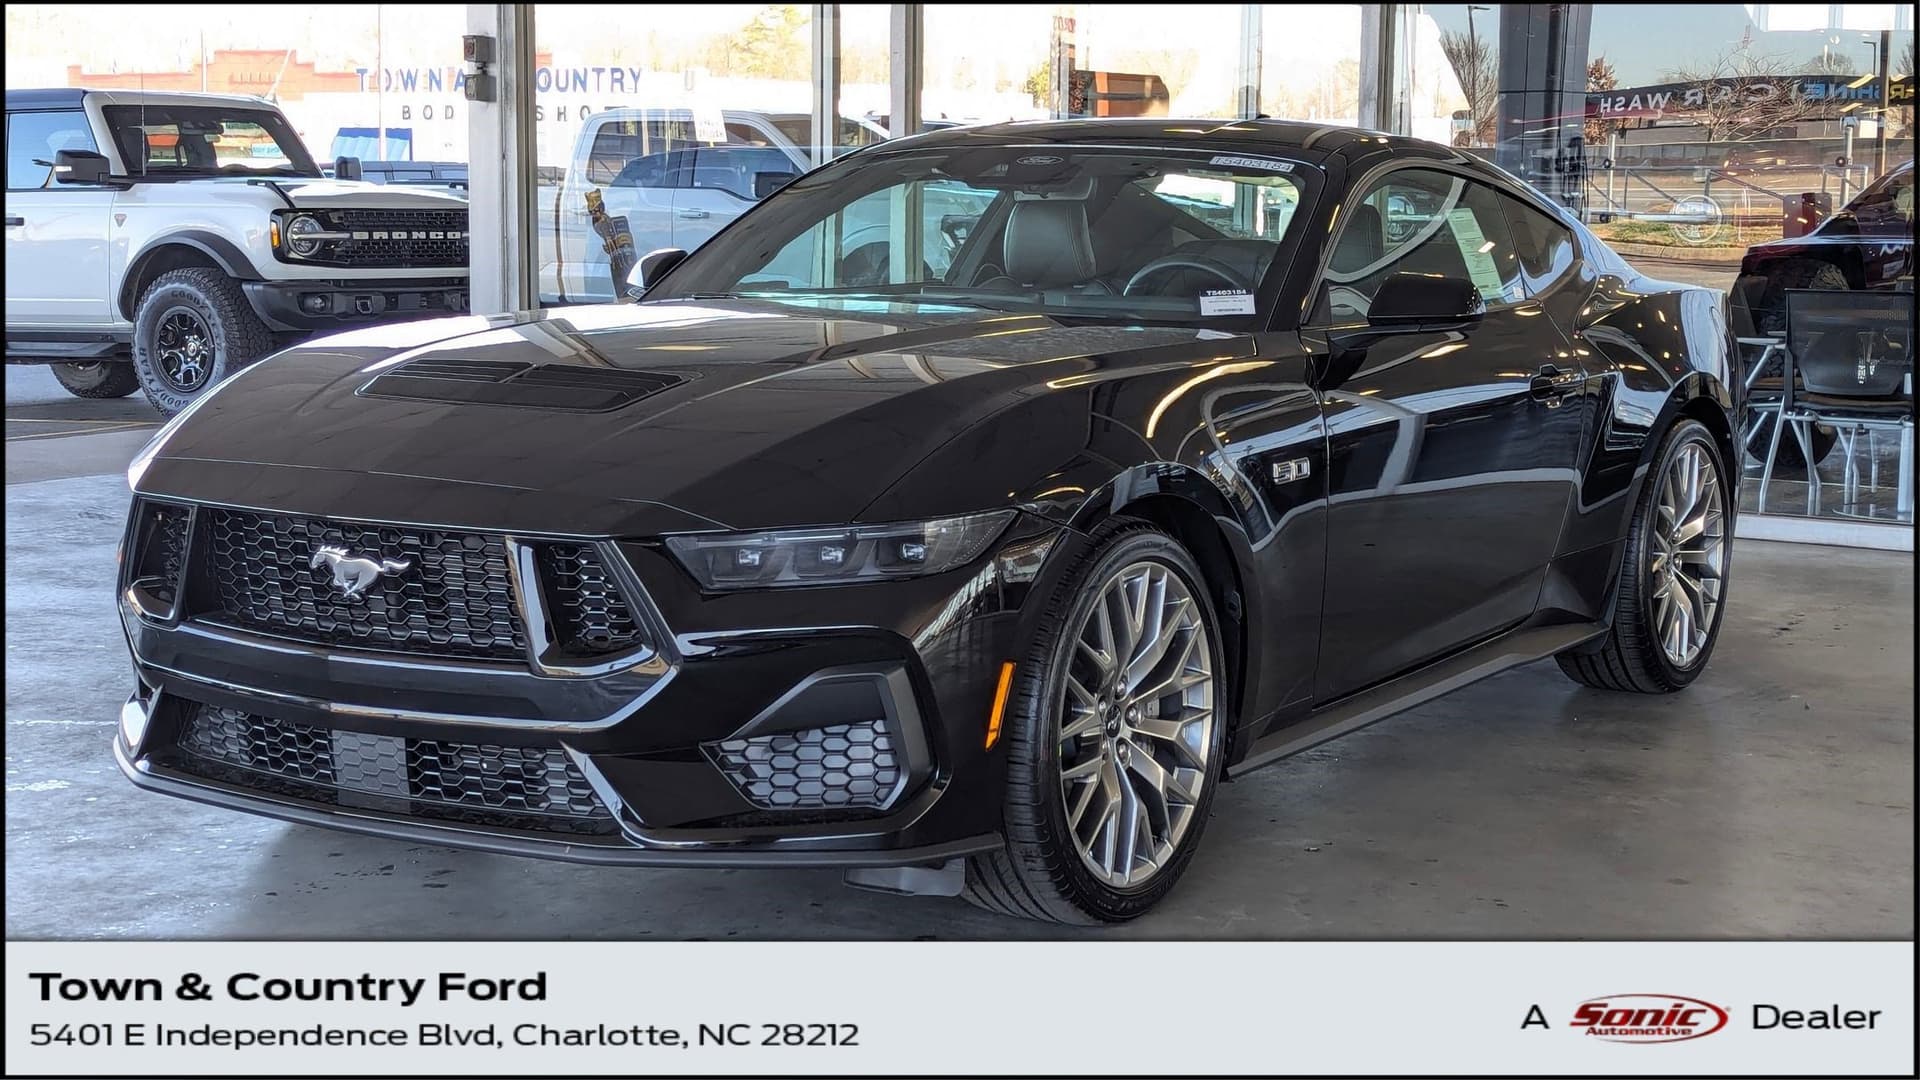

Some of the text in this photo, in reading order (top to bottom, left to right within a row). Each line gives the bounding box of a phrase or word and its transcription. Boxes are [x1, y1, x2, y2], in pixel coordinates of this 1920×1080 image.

[356, 68, 442, 92] TOWN
[535, 67, 641, 93] OUNTRY
[535, 105, 591, 121] SHO
[352, 231, 461, 240] BRONCO
